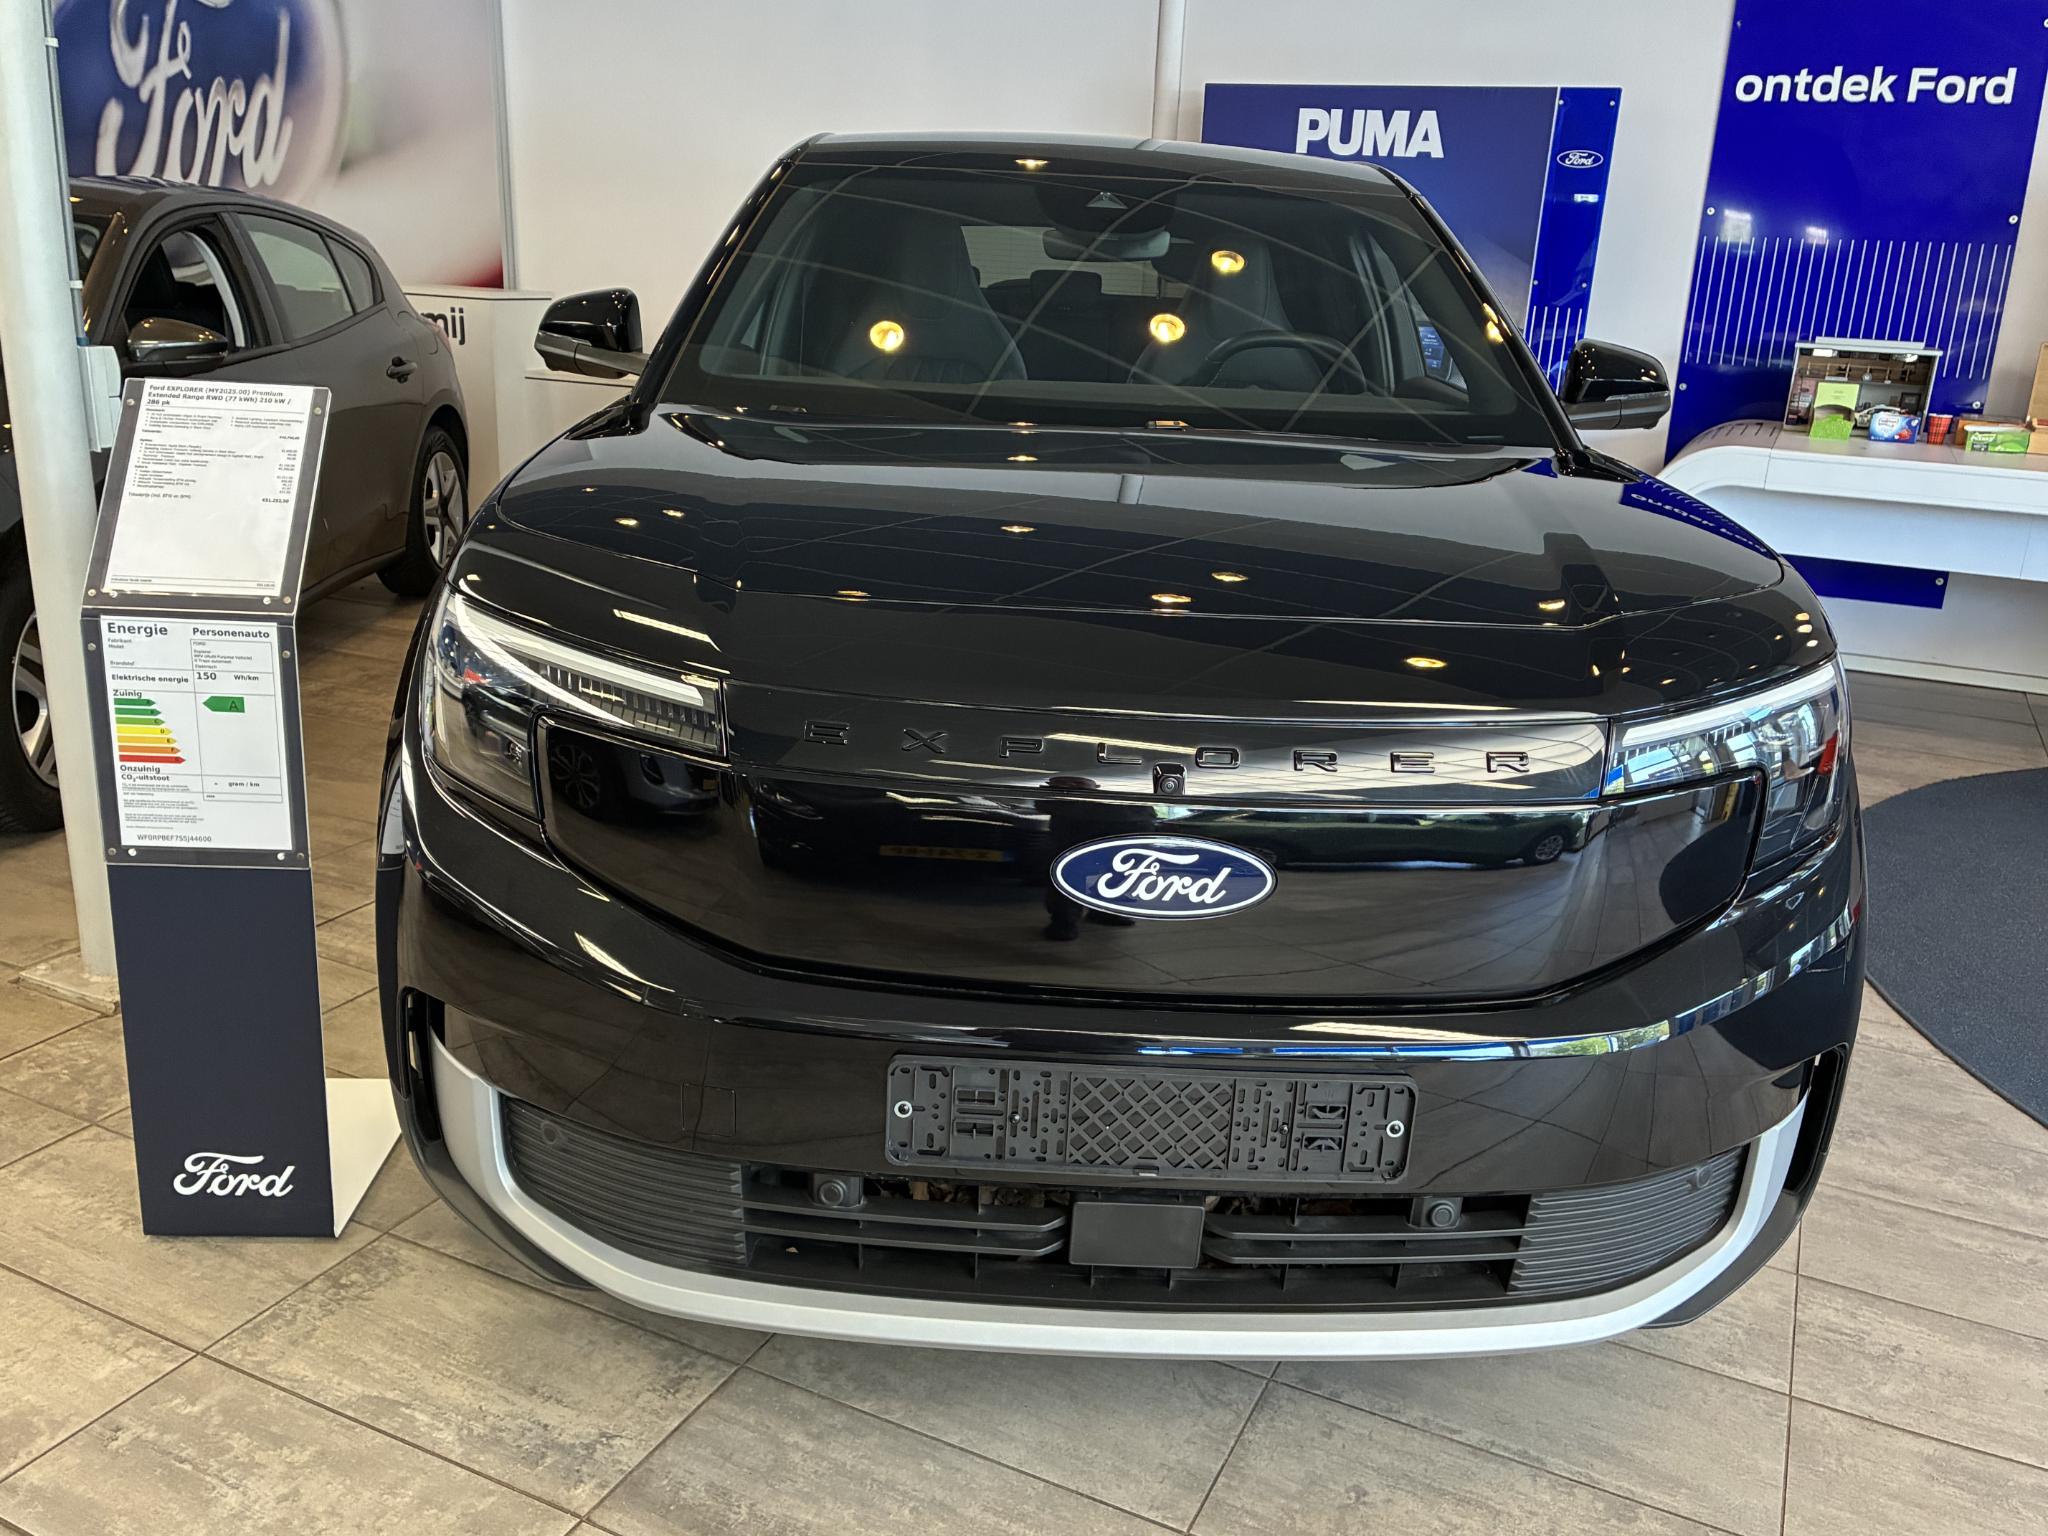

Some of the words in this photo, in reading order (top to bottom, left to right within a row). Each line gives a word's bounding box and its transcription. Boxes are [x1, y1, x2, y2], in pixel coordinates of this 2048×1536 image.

[1735, 65, 1898, 103] ontdek
[1906, 67, 2018, 104] Ford
[95, 0, 294, 188] Ford
[1295, 107, 1444, 159] PUMA
[1565, 152, 1595, 165] Ford
[148, 391, 181, 399] Extended
[182, 393, 205, 401] Range
[167, 385, 204, 393] EXPLORER
[252, 389, 283, 397] Premium
[107, 622, 168, 637] Energie
[192, 627, 270, 639] Personenauto
[111, 674, 156, 682] Elektrische
[158, 676, 189, 684] energie
[196, 671, 217, 681] 150
[233, 673, 259, 681] Wh/km
[112, 689, 142, 699] Zuinig
[229, 700, 239, 711] A
[804, 719, 1530, 775] EXPLORER
[119, 764, 161, 774] Onzuinig
[1097, 848, 1232, 904] Ford
[173, 1152, 296, 1198] Ford
